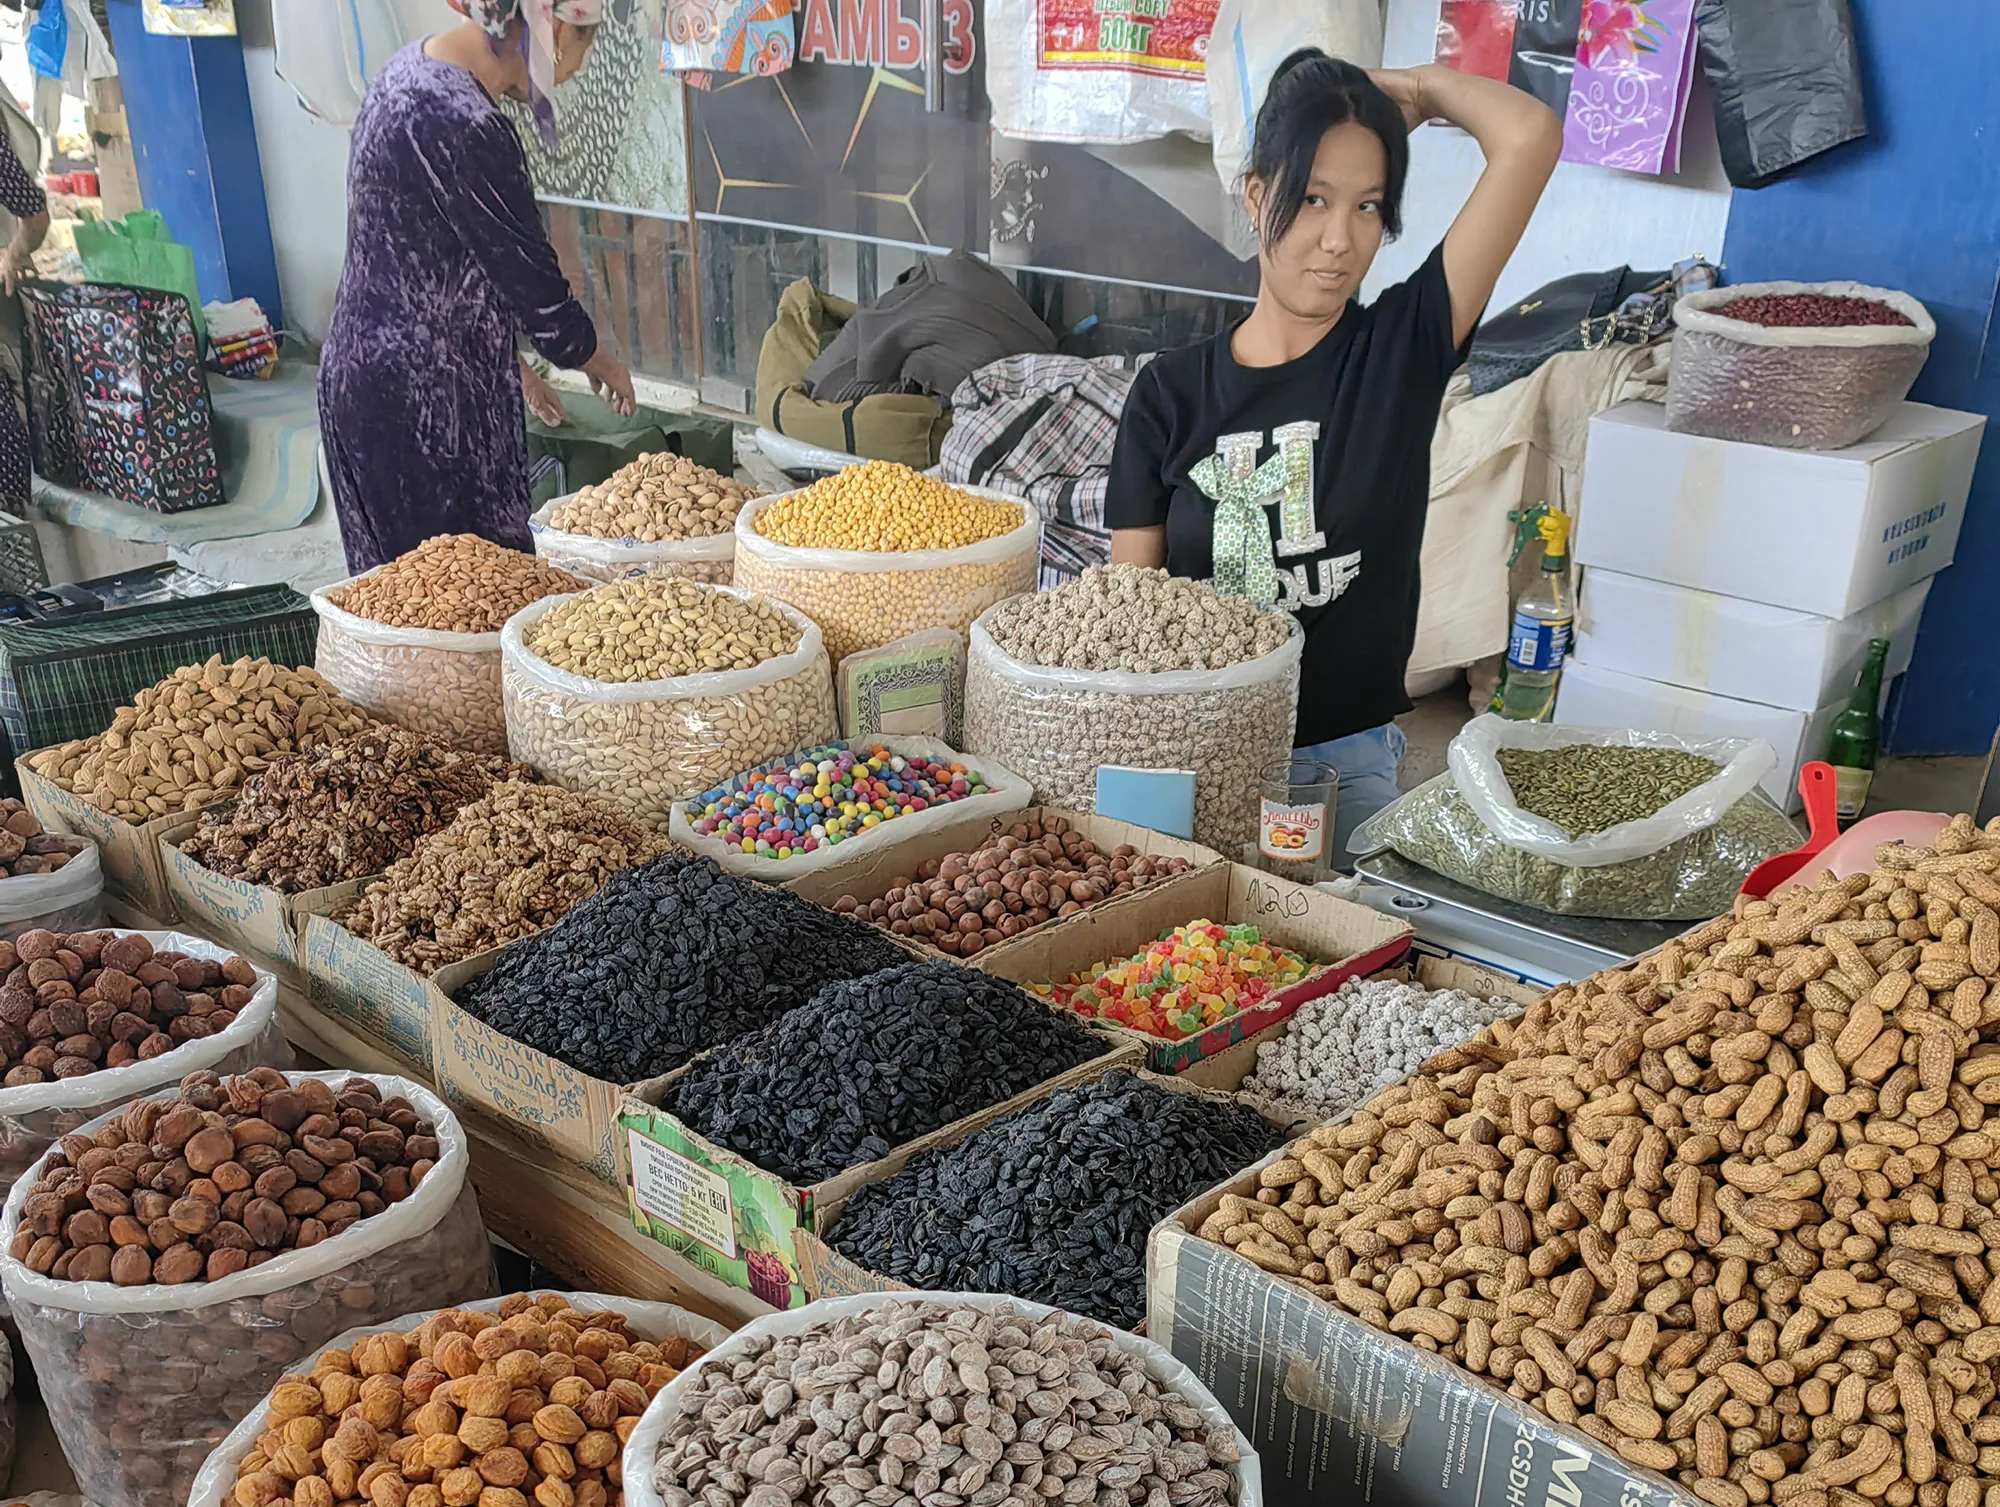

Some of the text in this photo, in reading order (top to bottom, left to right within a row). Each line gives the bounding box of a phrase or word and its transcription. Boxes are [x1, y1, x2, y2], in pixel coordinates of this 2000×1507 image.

[1246, 878, 1309, 918] 120
[467, 1035, 558, 1099] РУССКОЕ
[647, 1164, 663, 1178] ВЕС
[690, 1186, 696, 1197] 5
[697, 1189, 707, 1203] КГ
[1240, 1372, 1245, 1381] va
[1238, 1382, 1246, 1408] isitish
[1415, 1384, 1423, 1407] слив
[1266, 1387, 1279, 1440] перезапуска
[1320, 1435, 1330, 1471] воздуха
[1447, 1424, 1457, 1452] поток
[1458, 1425, 1470, 1474] плотности
[1440, 1453, 1454, 1489] воздуха
[1544, 1439, 1593, 1507] M
[1620, 1481, 1652, 1507] ts
